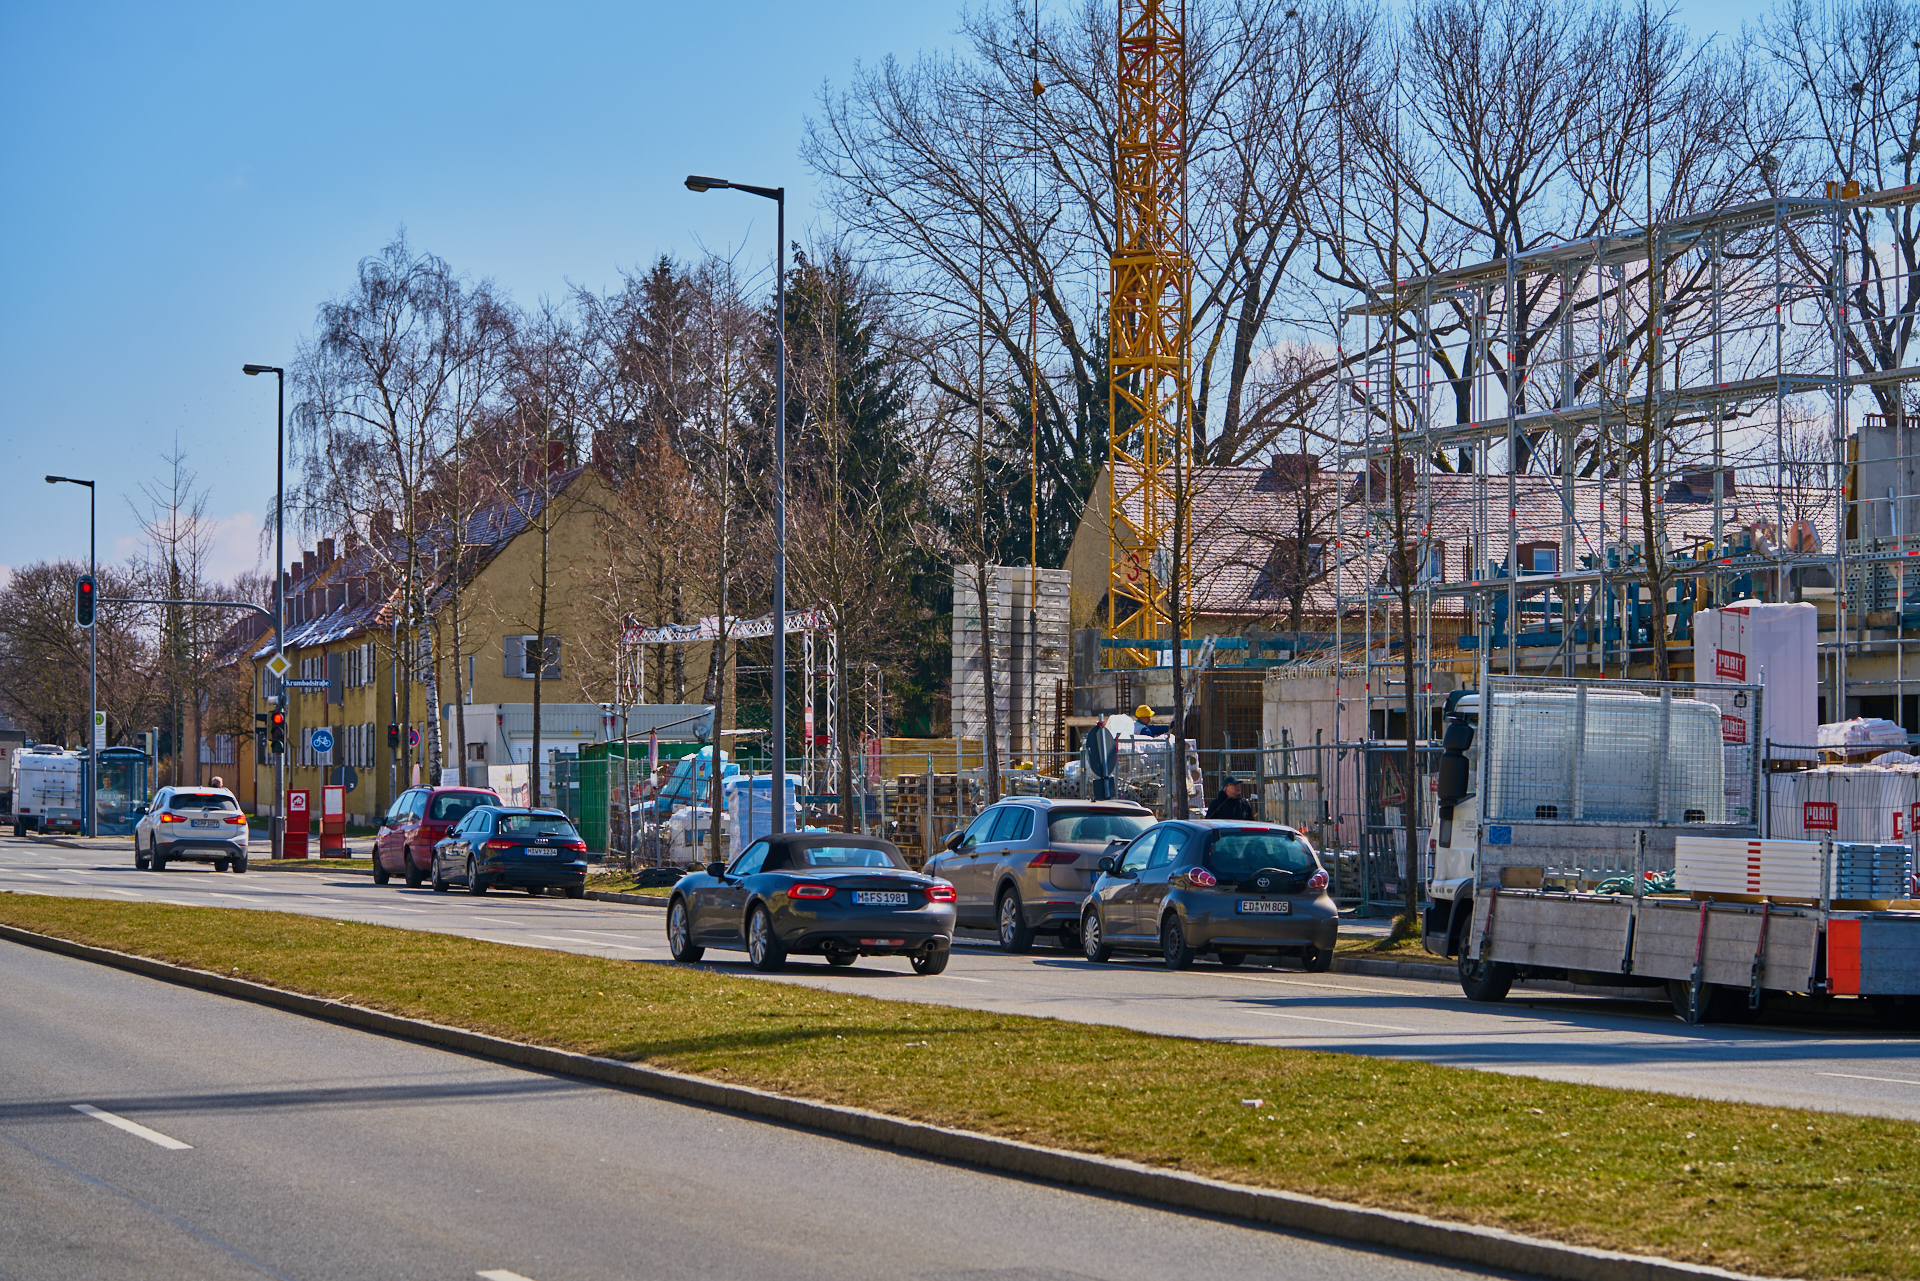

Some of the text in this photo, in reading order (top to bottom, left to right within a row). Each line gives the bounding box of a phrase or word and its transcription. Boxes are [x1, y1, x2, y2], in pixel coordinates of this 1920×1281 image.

[1127, 554, 1139, 581] 3
[1719, 654, 1743, 671] PORIT
[1806, 807, 1834, 821] PORIT
[857, 893, 906, 903] M FS 1981
[1243, 902, 1288, 912] ED YM 805
